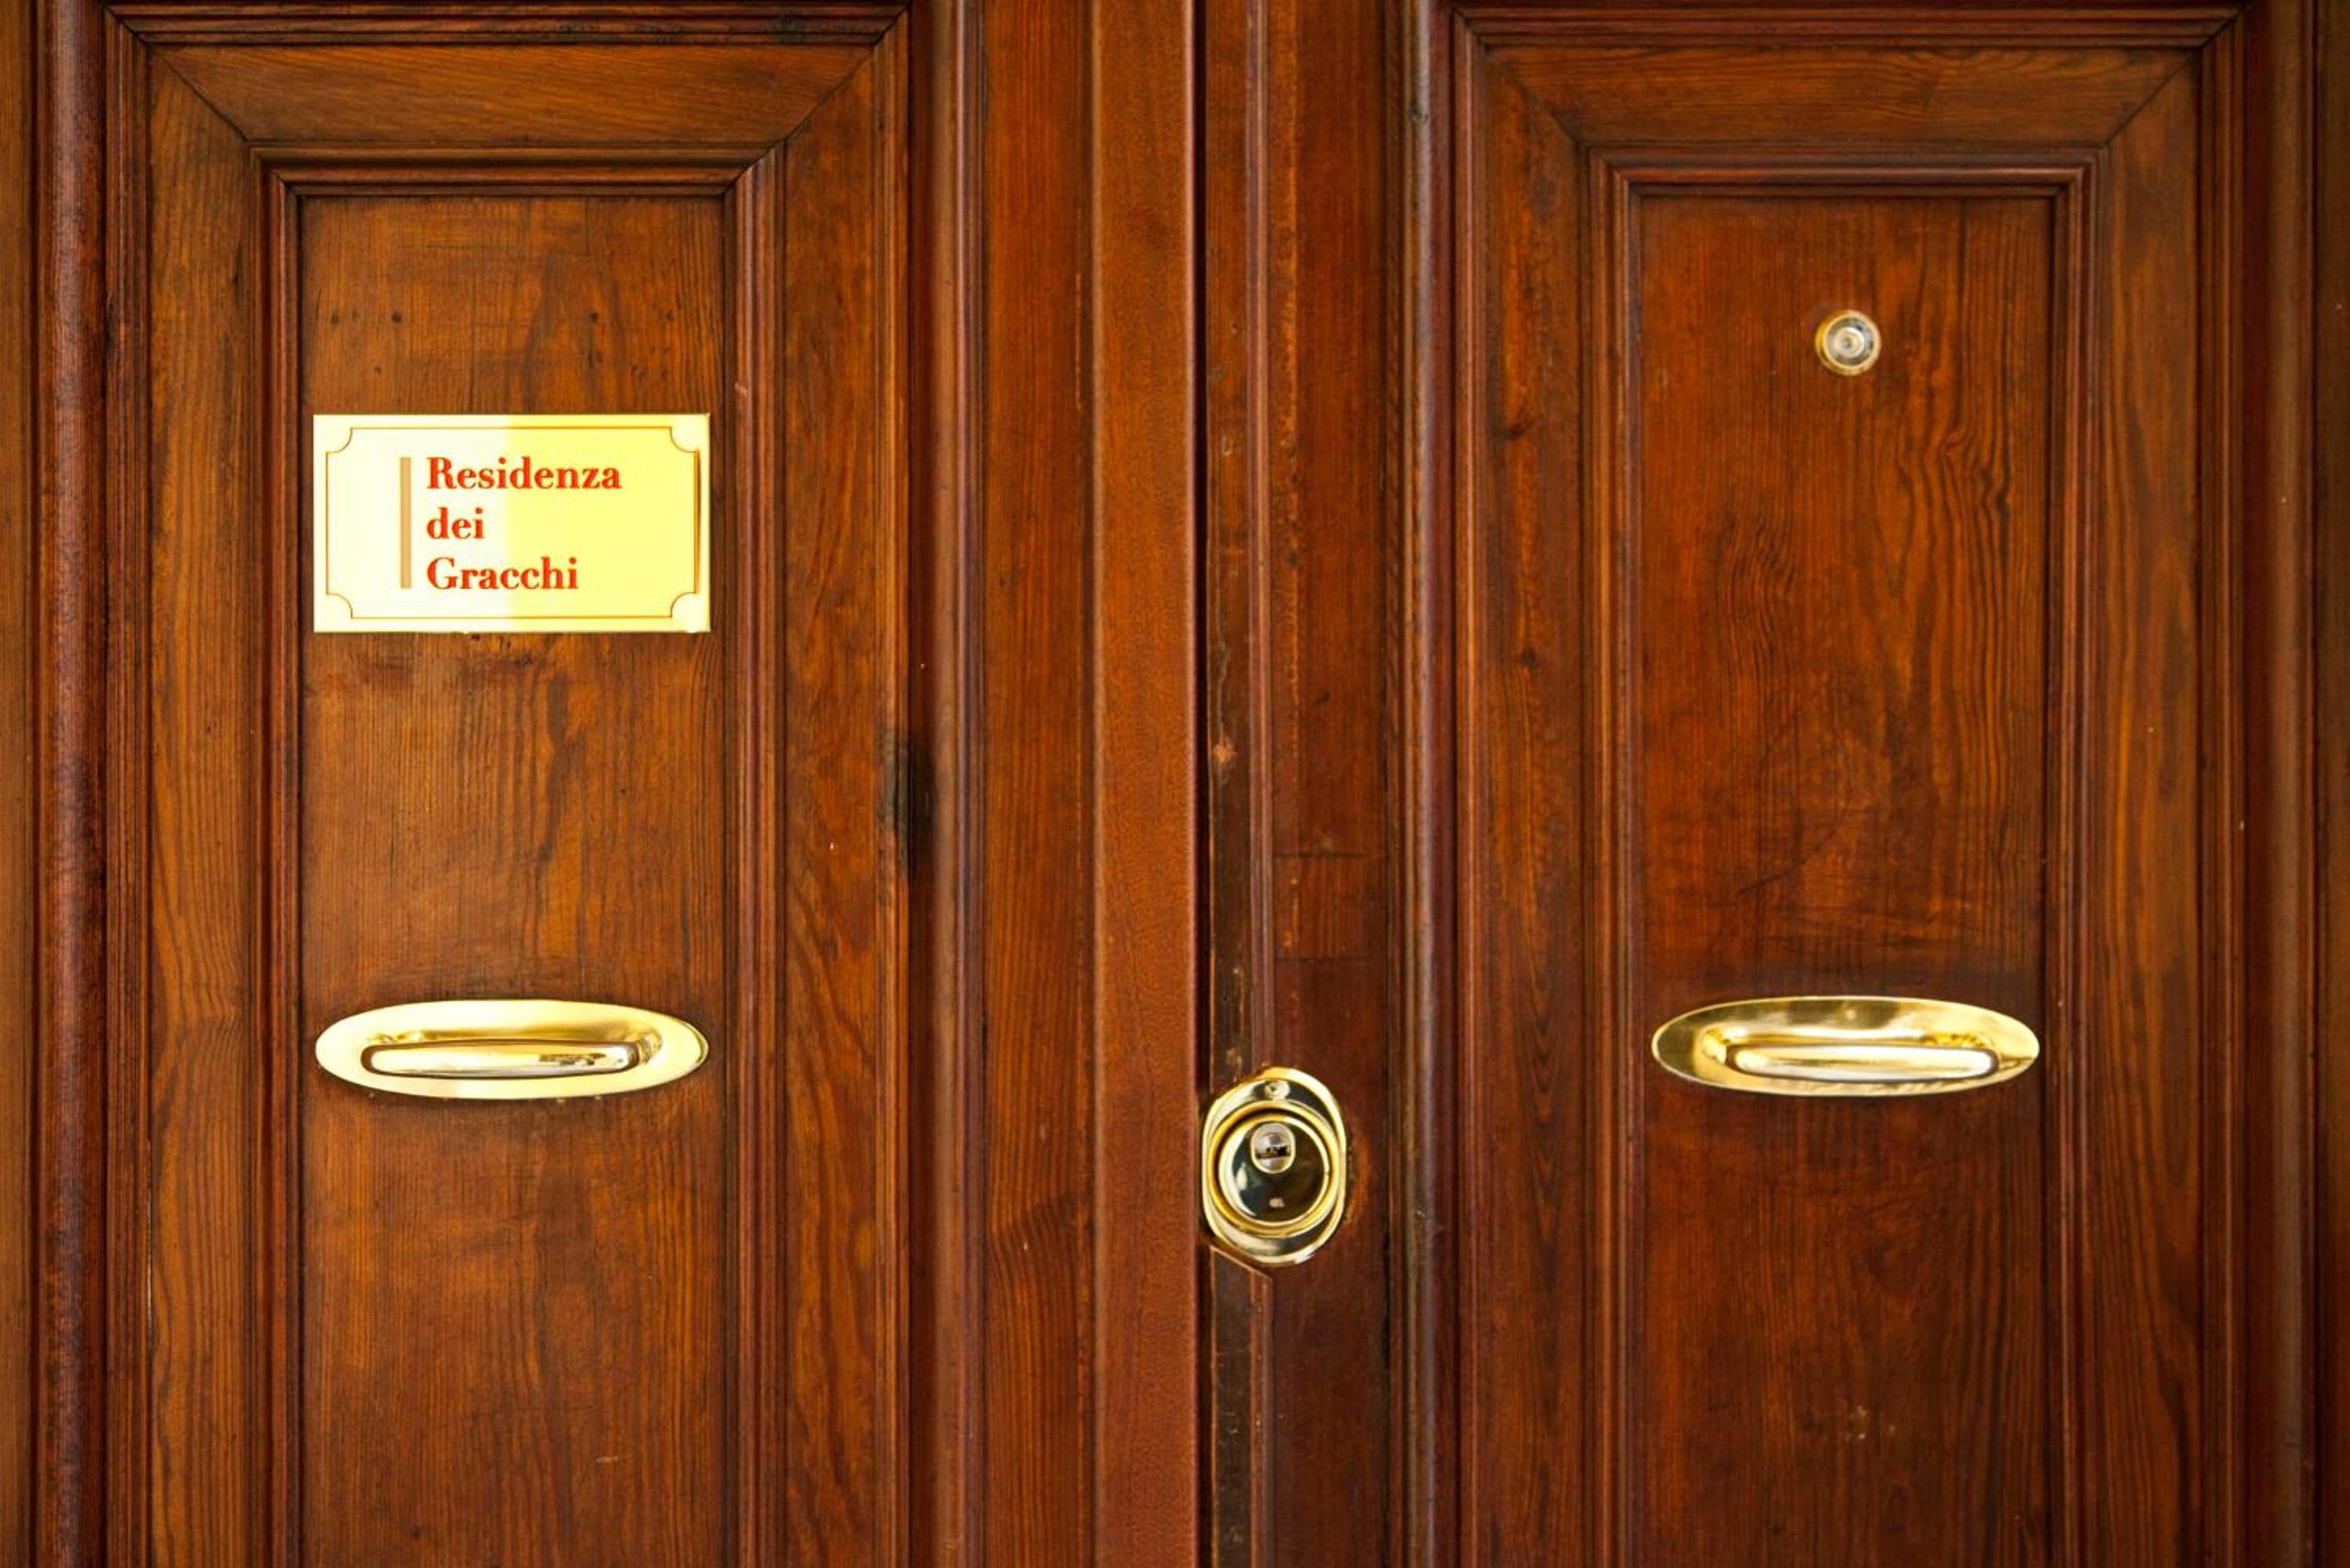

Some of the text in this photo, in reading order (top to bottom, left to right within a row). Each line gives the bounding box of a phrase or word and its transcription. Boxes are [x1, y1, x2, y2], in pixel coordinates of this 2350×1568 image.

[426, 456, 622, 490] Residenza
[426, 507, 485, 540] dei
[426, 556, 578, 590] Gracchi
